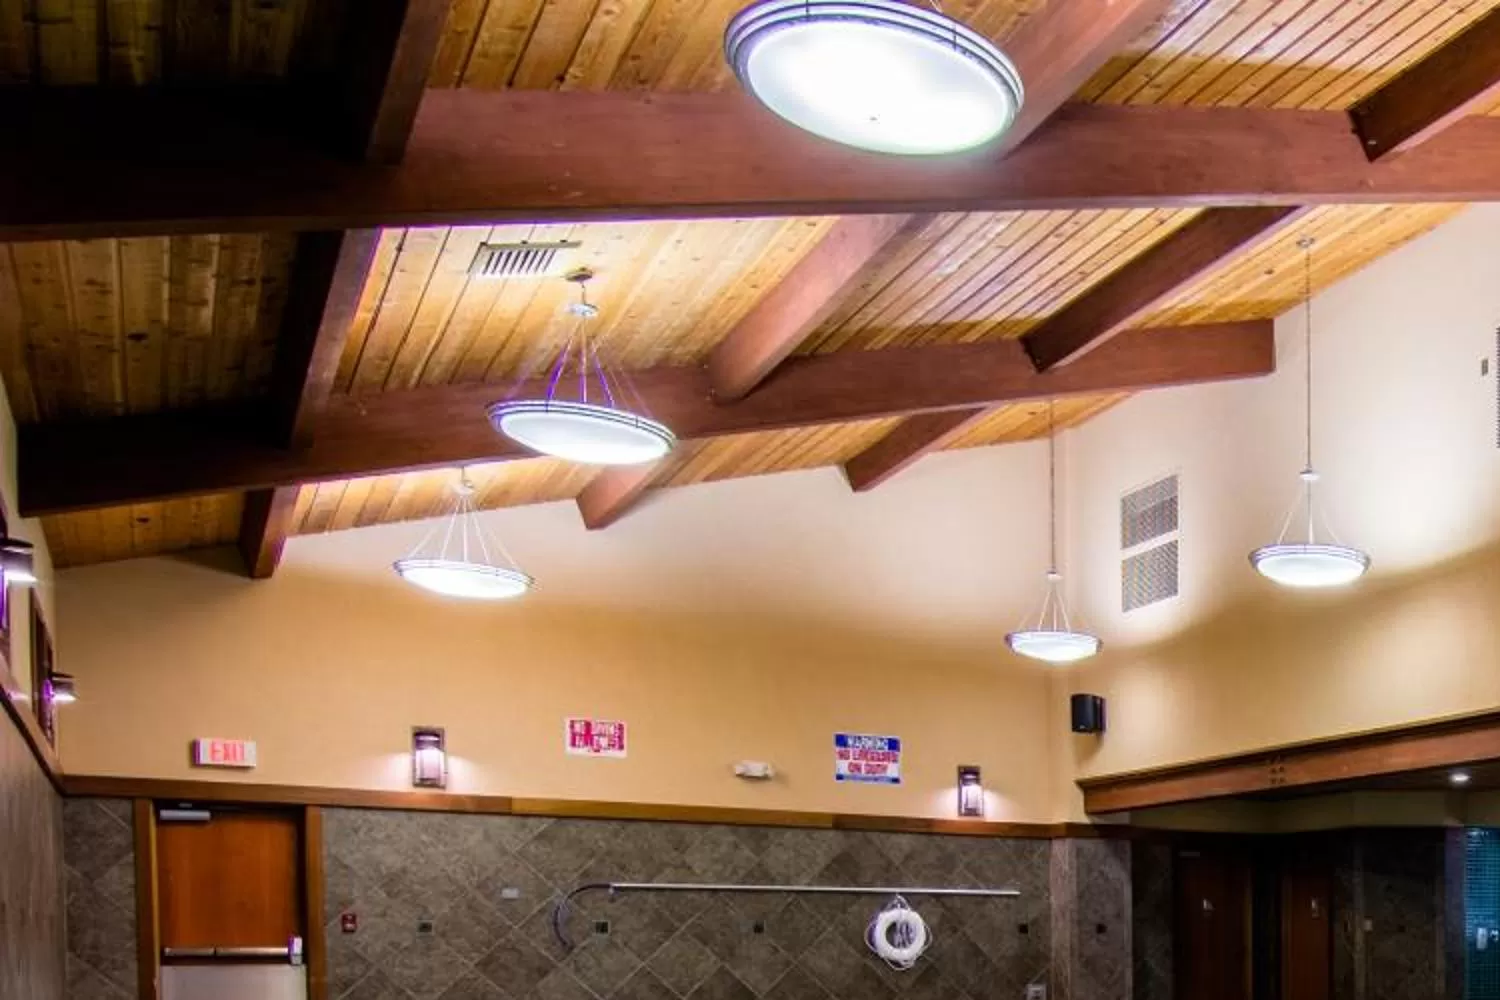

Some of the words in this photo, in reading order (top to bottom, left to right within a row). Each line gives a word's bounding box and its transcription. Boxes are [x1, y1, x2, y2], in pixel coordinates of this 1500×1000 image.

[209, 742, 245, 761] EXIT
[837, 749, 850, 761] NO
[848, 762, 862, 774] ON
